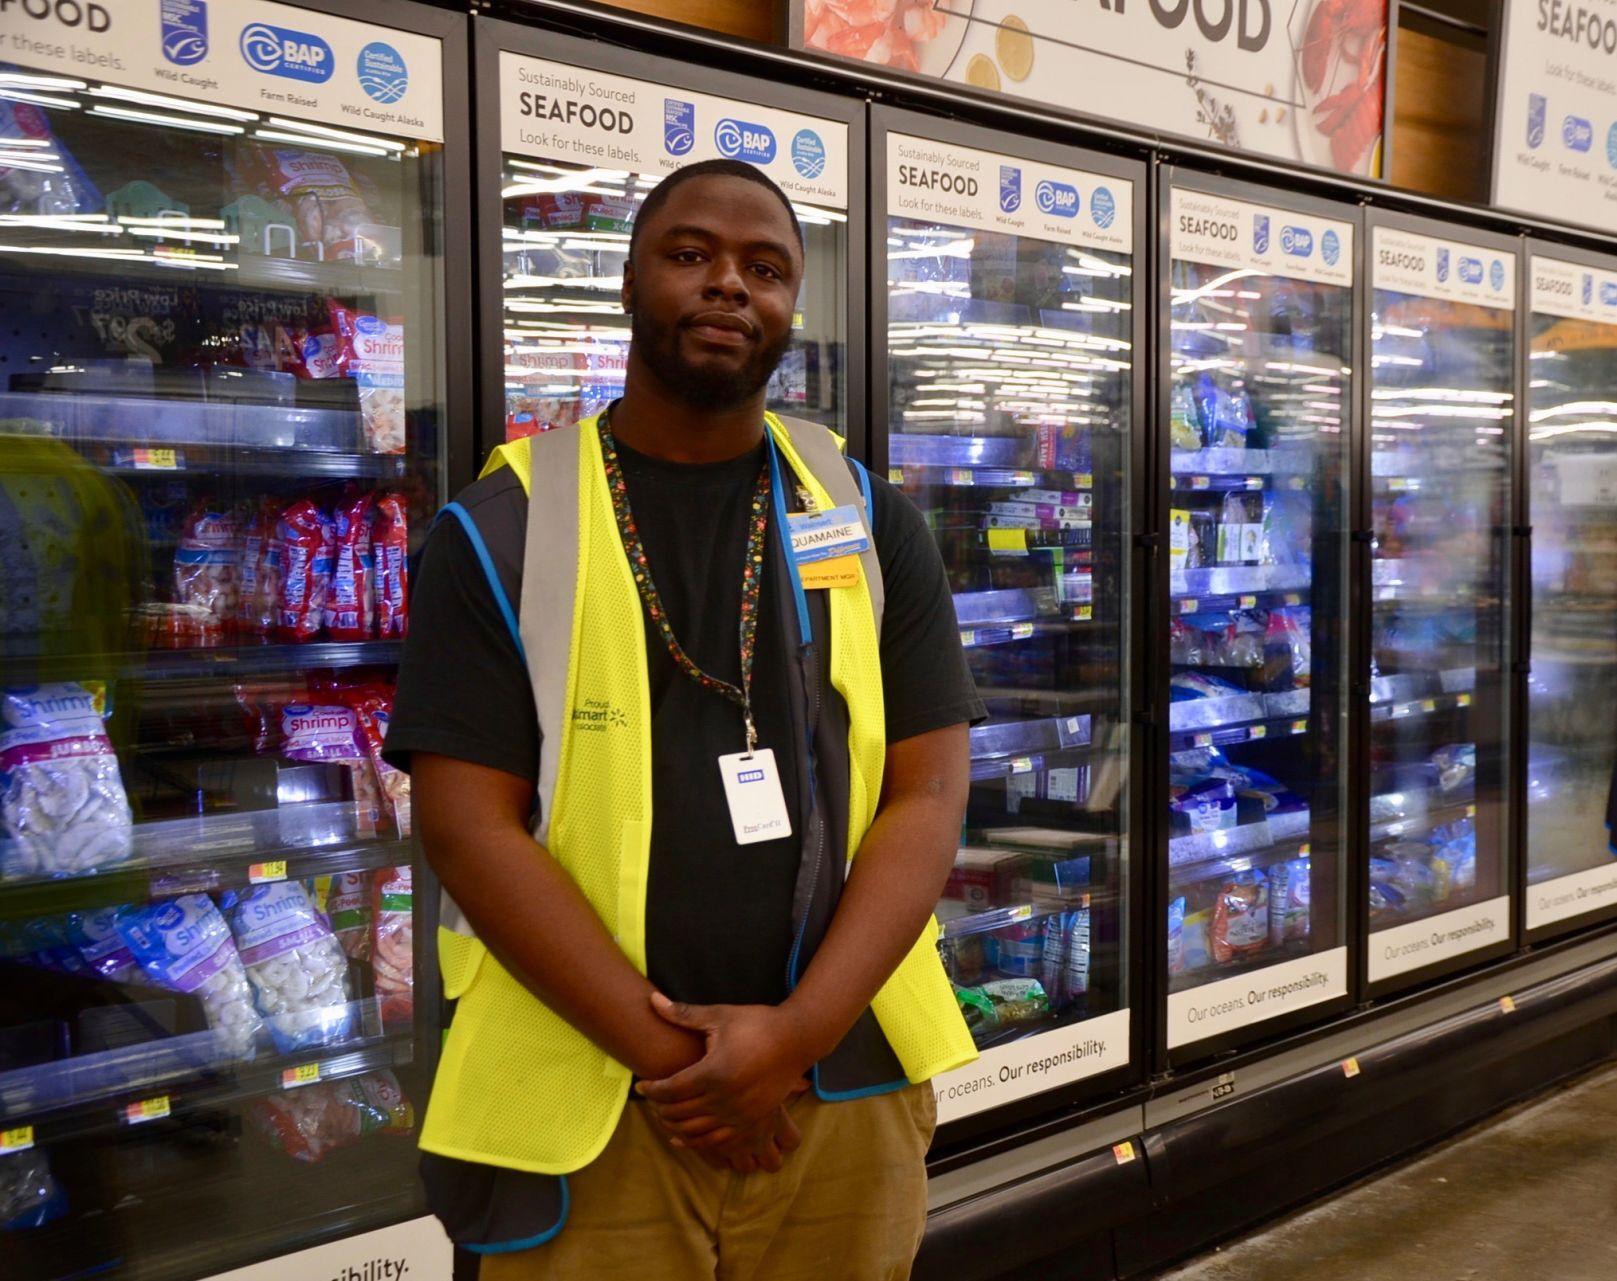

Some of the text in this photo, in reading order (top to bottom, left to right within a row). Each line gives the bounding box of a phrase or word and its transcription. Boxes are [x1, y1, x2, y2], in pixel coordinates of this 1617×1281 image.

[11, 34, 127, 71] these labels.
[283, 40, 325, 66] BAP
[155, 67, 218, 90] Wild Caught
[284, 62, 326, 75] CERTIFIED
[518, 67, 636, 104] Sustainably Sourced
[261, 88, 318, 108] Farm Raised
[341, 104, 425, 127] Wild Caught Alaska
[520, 91, 634, 134] SEAFOOD
[520, 129, 642, 163] Look for these labels.
[743, 132, 770, 151] BAP
[659, 159, 675, 170] Wild
[898, 144, 980, 171] Sustainably Sourced
[780, 180, 836, 198] Wild Caught Alaska
[899, 164, 978, 197] SEAFOOD
[898, 195, 983, 220] Look for these labels.
[1055, 189, 1076, 207] BAP
[1180, 215, 1238, 241] SEAFOOD
[1380, 249, 1425, 272] SEAFOOD
[1535, 276, 1573, 296] SEAFOOD
[520, 354, 569, 369] Shrimp
[801, 574, 839, 582] PARTMENT
[290, 715, 350, 732] Shrimp
[254, 894, 307, 921] Shrimp
[1431, 933, 1446, 946] Our
[1188, 972, 1330, 1023] Our oceans. Our responsibility.
[948, 1074, 996, 1100] oceans.
[999, 1065, 1024, 1083] Our
[1026, 1040, 1107, 1075] responsibility.
[331, 1258, 409, 1281] ibility.
